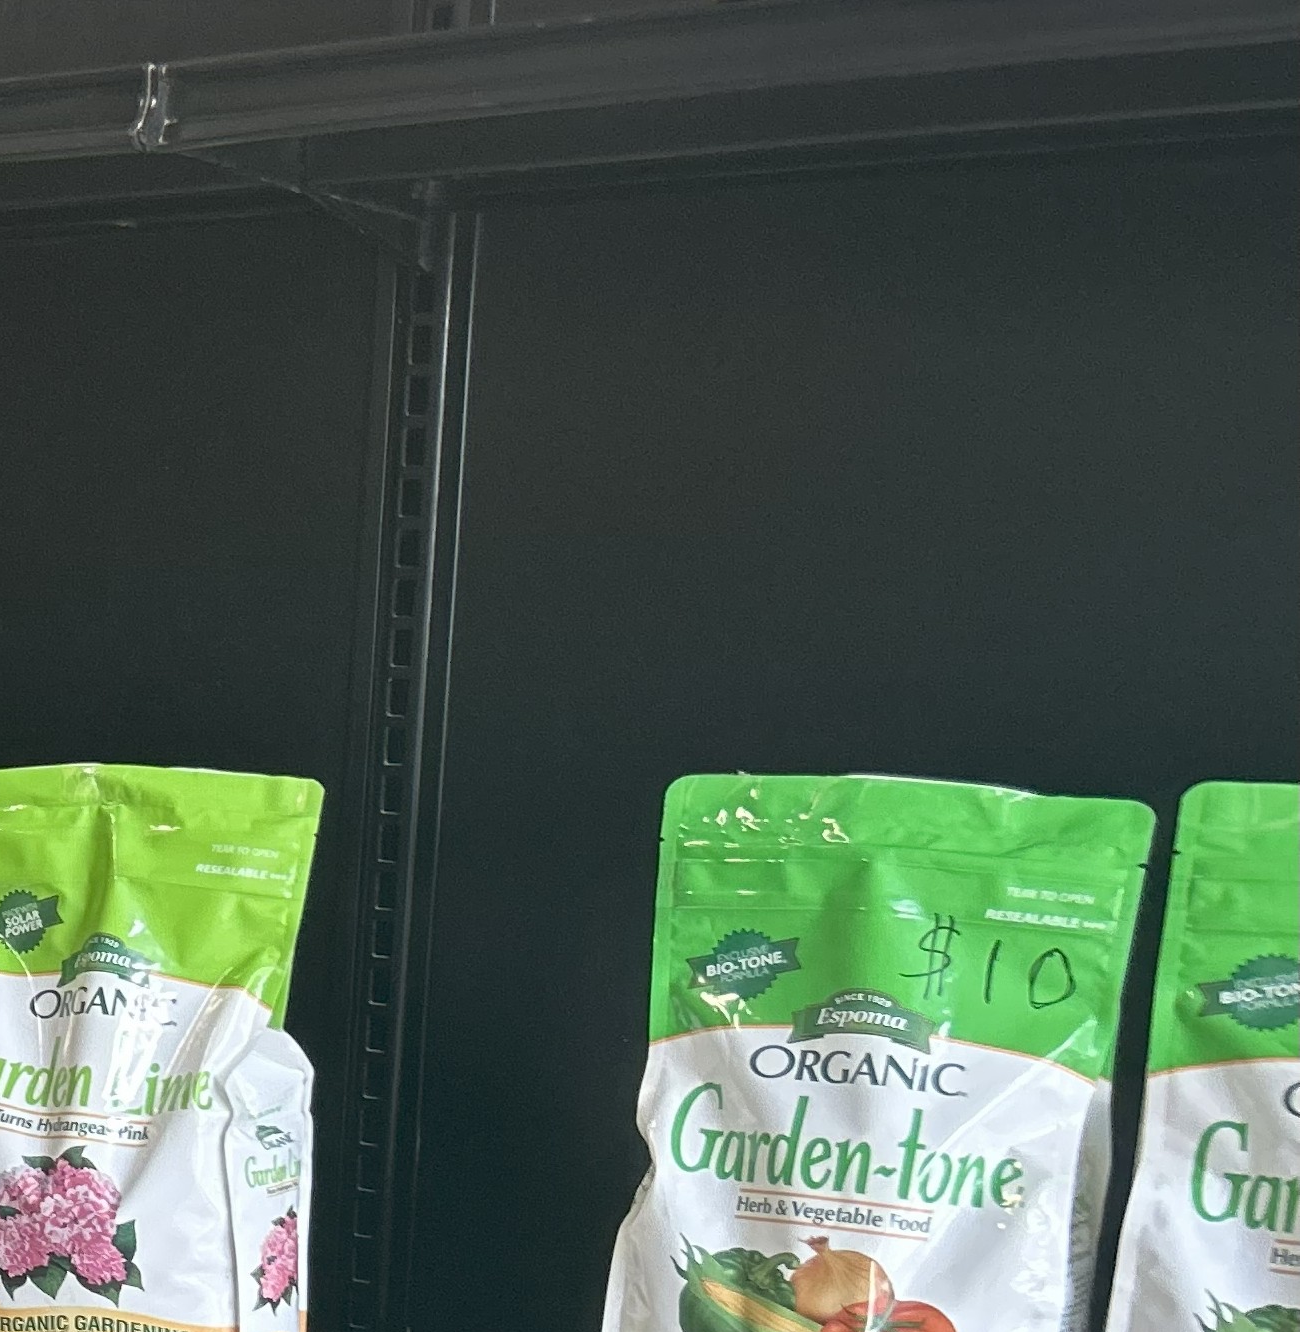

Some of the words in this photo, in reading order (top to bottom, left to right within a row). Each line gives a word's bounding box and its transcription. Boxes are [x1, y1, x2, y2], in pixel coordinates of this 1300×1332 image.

[4, 918, 44, 938] POWER
[5, 909, 41, 929] SOLAR
[705, 951, 787, 978] BIO-TONE
[899, 912, 1076, 1009] $10
[816, 1007, 911, 1031] Espoma
[749, 1043, 968, 1098] ORGANIC
[670, 1081, 1025, 1209] Garden-tone
[736, 1195, 772, 1214] Herb
[775, 1199, 788, 1216] &
[792, 1200, 884, 1229] Vegetable
[888, 1213, 933, 1234] Food
